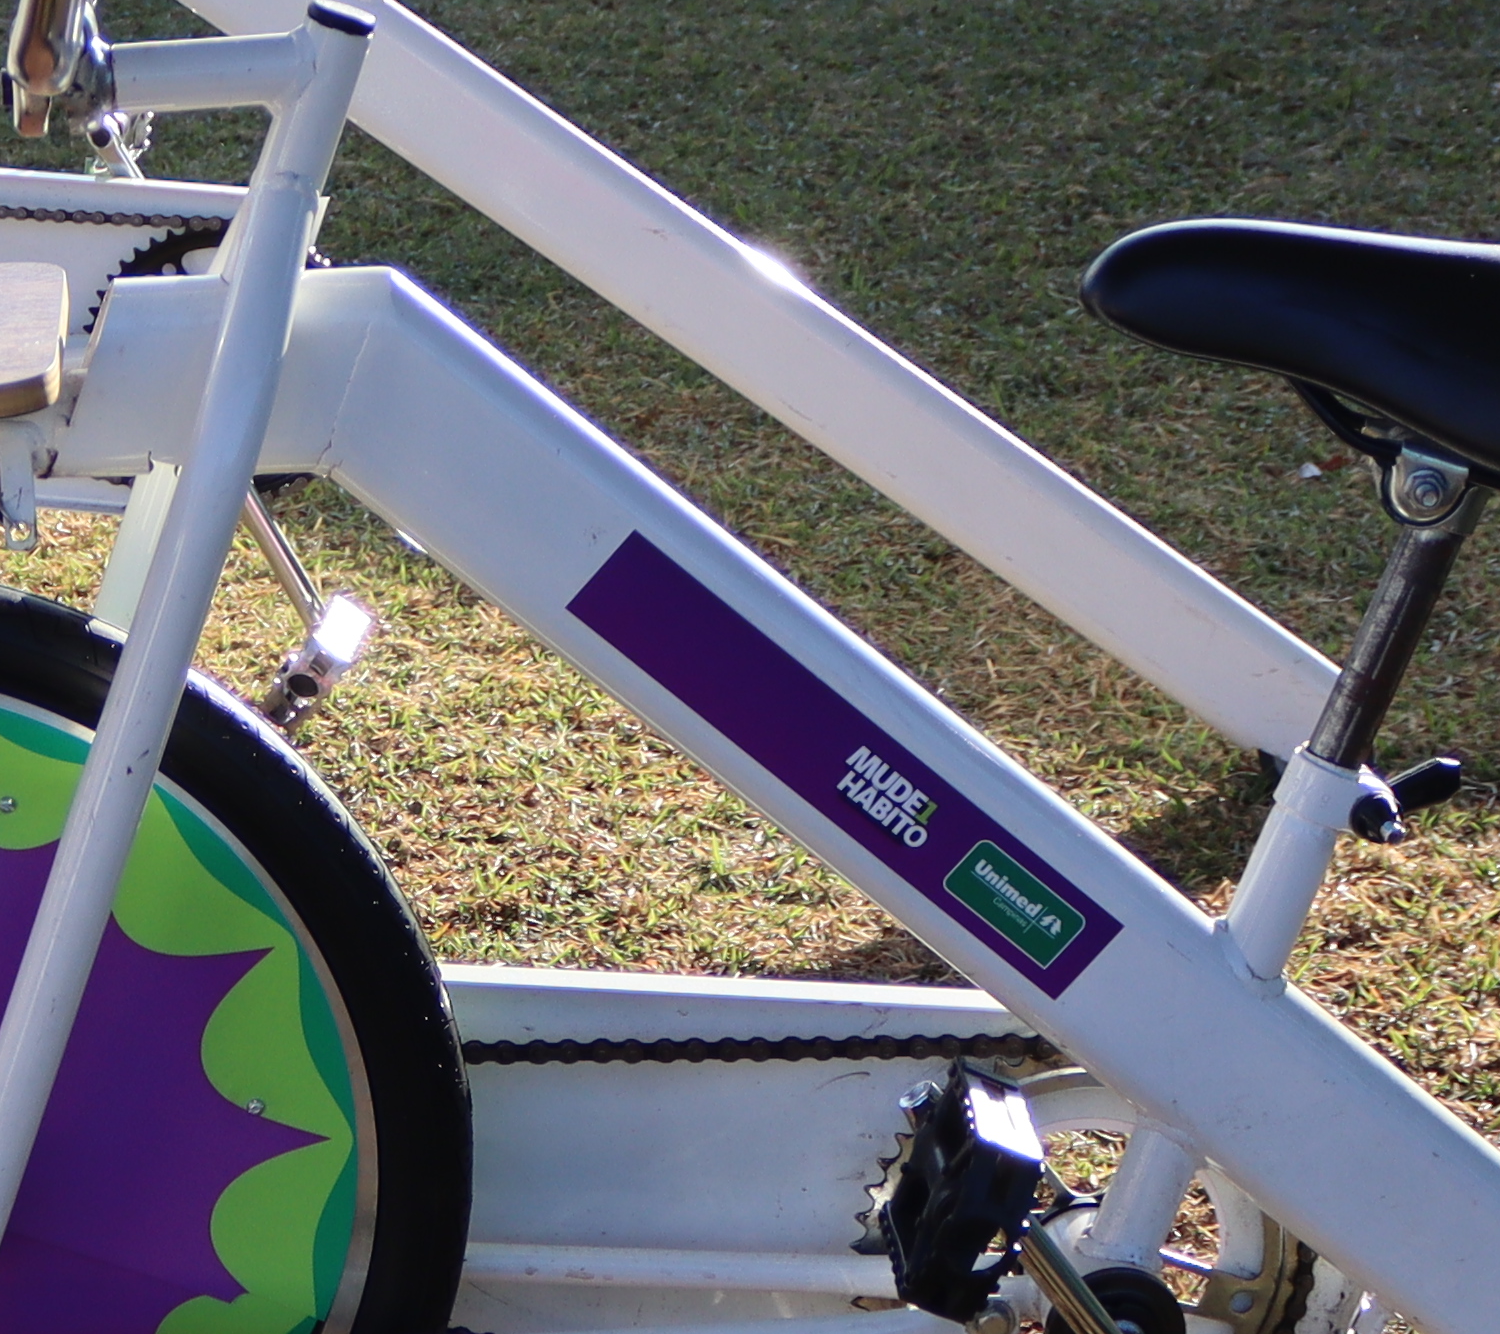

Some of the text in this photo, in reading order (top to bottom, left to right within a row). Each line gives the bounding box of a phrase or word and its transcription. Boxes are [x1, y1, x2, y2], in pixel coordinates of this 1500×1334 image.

[836, 770, 929, 848] HABITO
[974, 858, 1044, 918] Unimed
[993, 896, 1028, 929] Campinas
